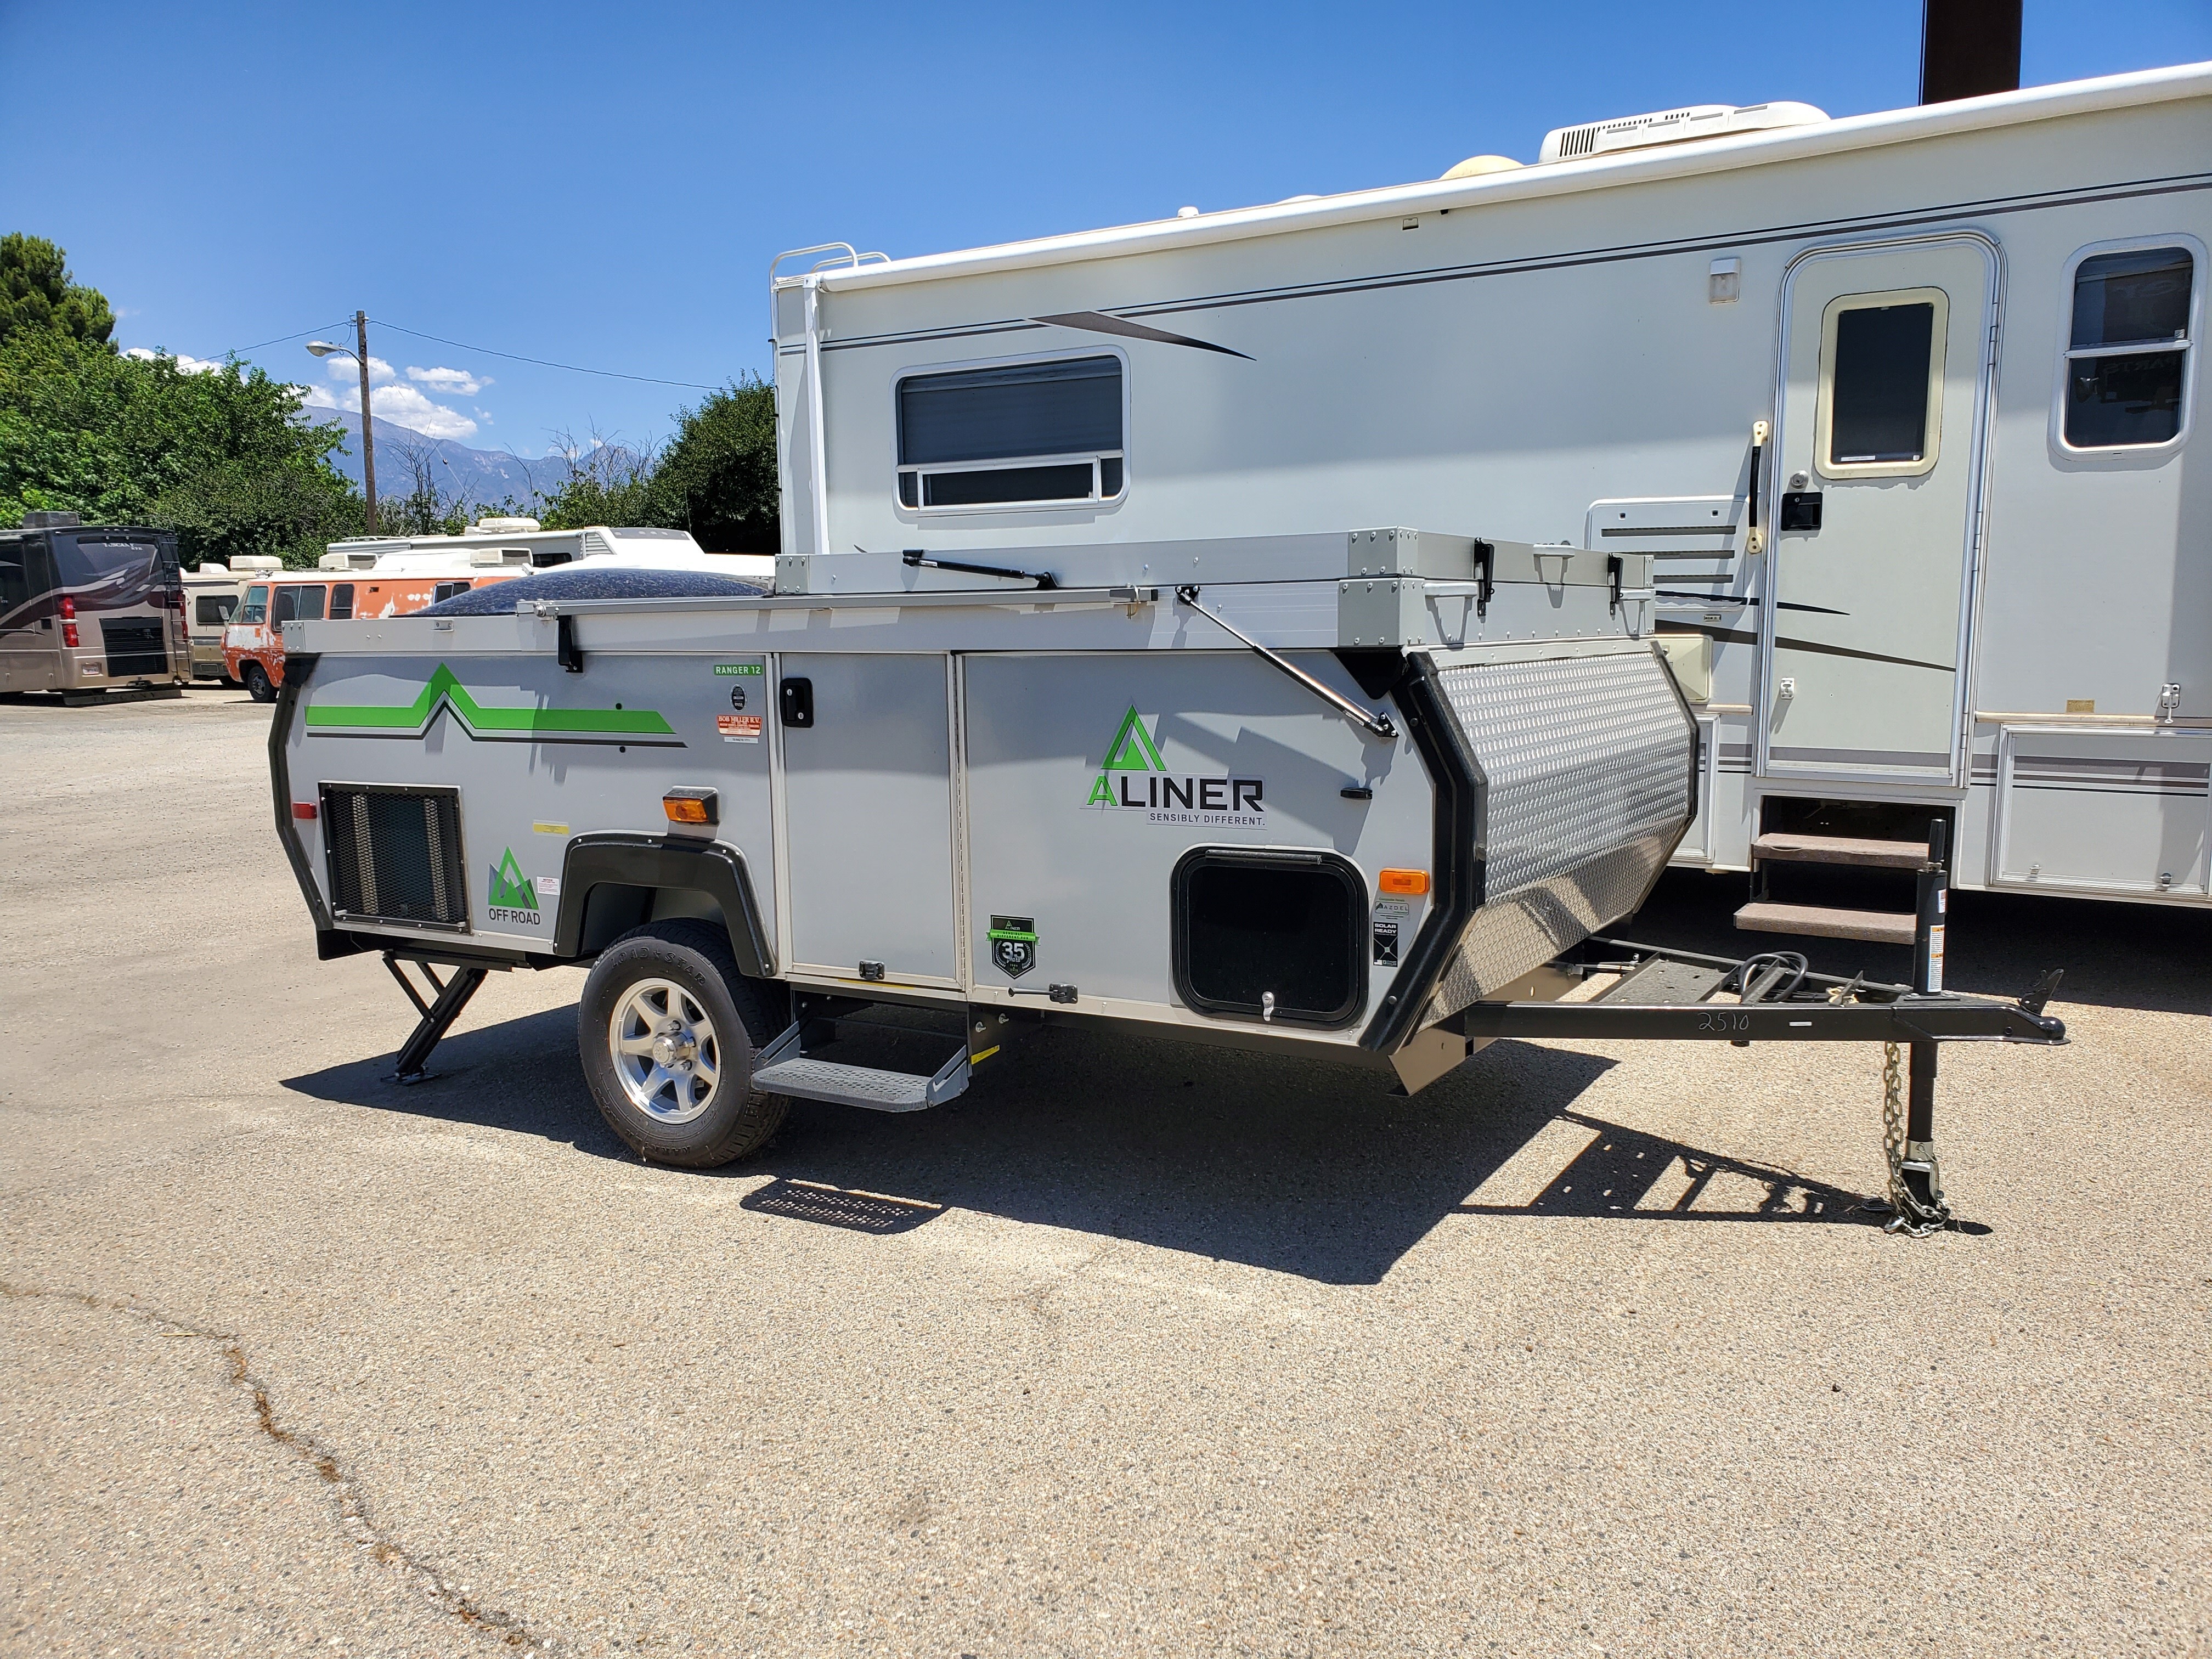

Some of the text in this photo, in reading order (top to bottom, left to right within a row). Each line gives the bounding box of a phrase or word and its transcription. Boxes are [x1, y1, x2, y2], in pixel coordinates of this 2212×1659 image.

[716, 666, 761, 674] RANGER 12
[1086, 775, 1264, 812] ALINER
[1150, 812, 1266, 826] SENSIBLY DIFFERENT.
[489, 908, 540, 925] OFF ROAD
[1002, 941, 1025, 960] 35
[1697, 1012, 1749, 1031] 2510
